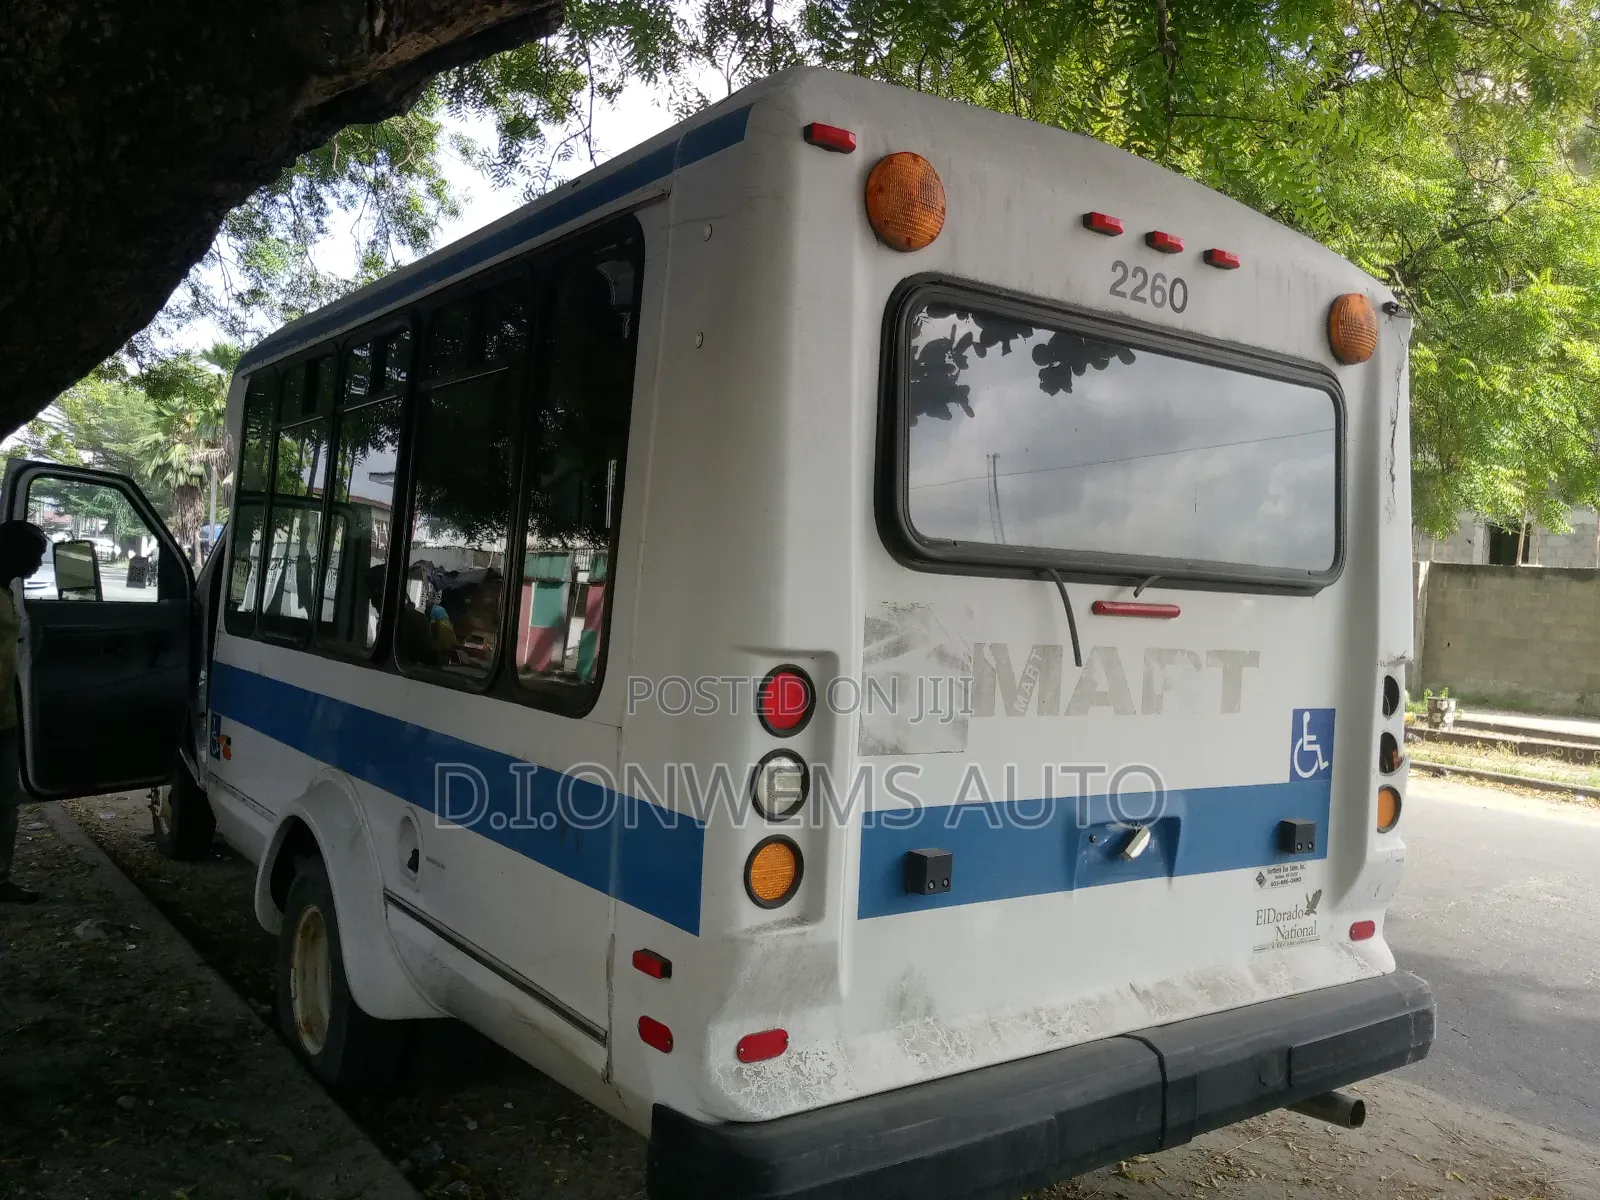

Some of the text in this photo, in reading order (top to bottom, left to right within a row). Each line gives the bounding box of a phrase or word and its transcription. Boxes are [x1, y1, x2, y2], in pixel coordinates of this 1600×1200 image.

[1109, 260, 1188, 314] 2260
[1013, 649, 1043, 714] MART
[1255, 904, 1304, 926] ElDorado
[1276, 920, 1317, 941] National
